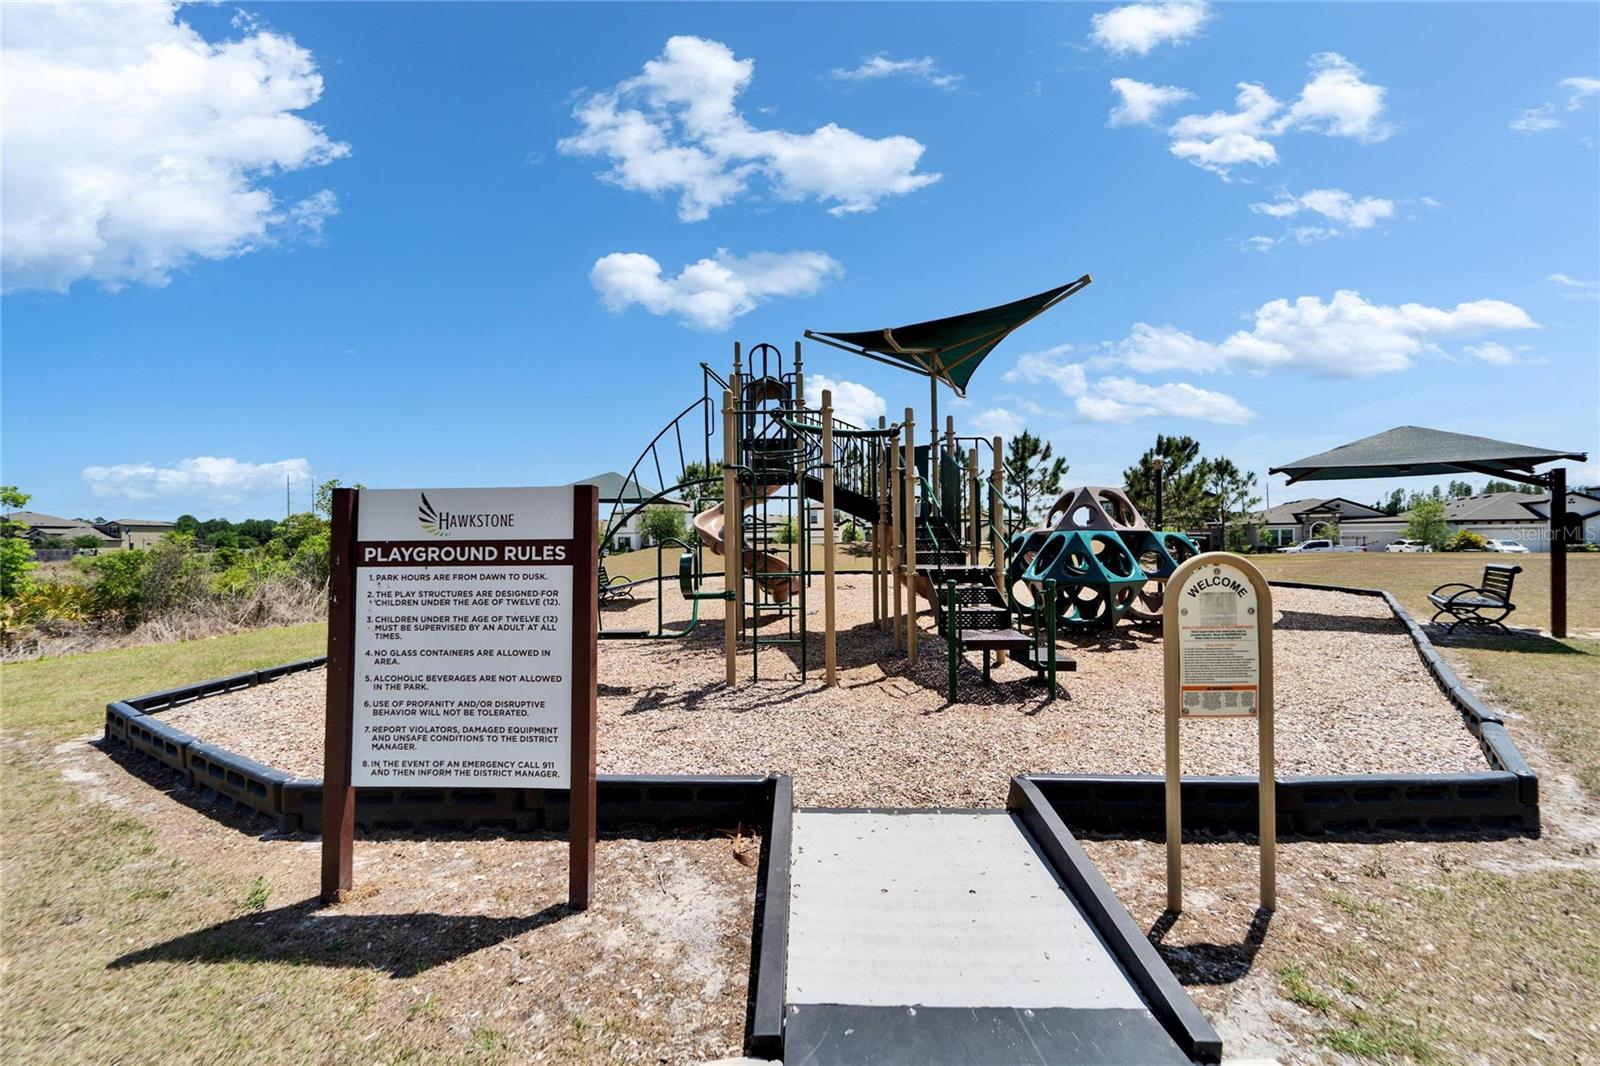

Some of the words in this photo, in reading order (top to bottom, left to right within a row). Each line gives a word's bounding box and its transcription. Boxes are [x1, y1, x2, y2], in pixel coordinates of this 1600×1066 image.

[364, 547, 498, 562] PLAYGROUND
[504, 545, 566, 560] RULES
[1187, 576, 1248, 598] WELCOME
[458, 700, 492, 708] AND/OR
[409, 726, 460, 734] VIOLATORS,
[515, 770, 560, 778] MANAGER.
